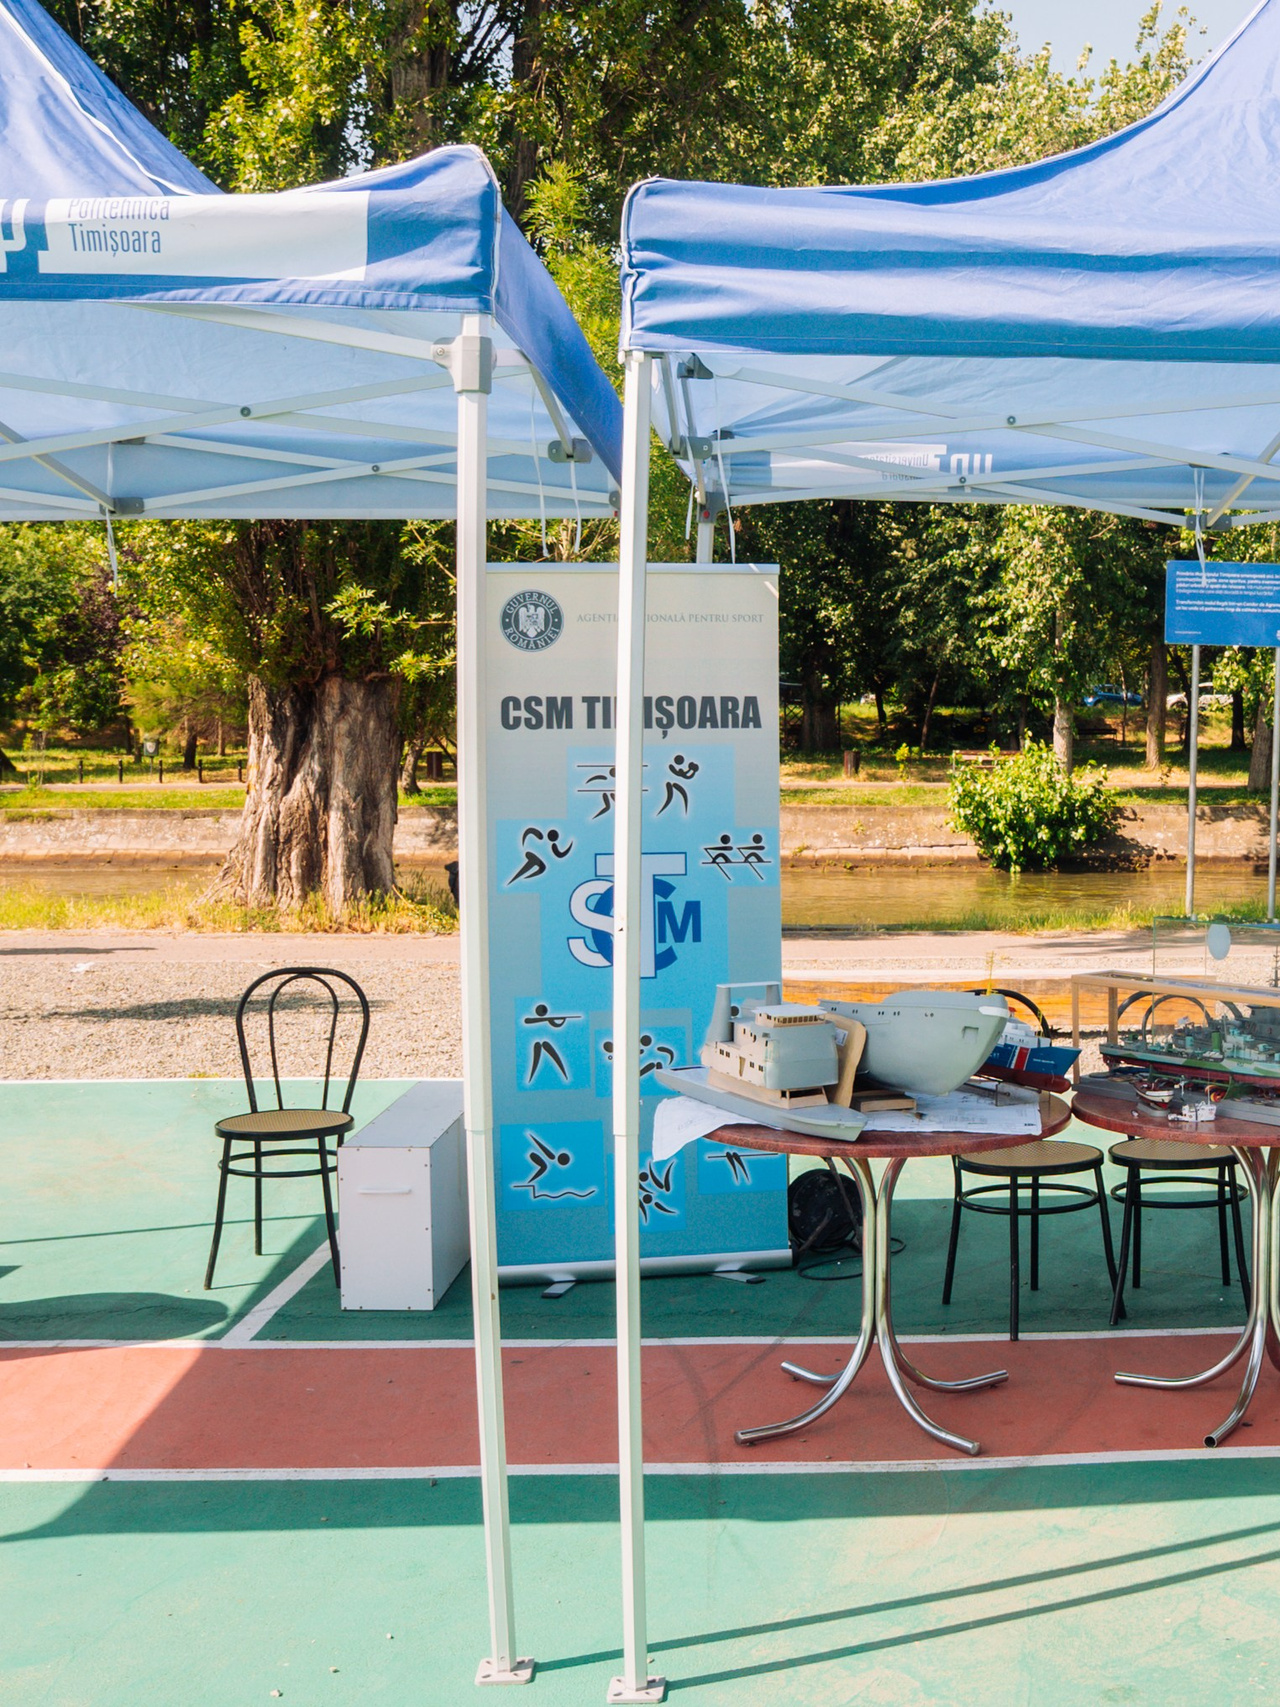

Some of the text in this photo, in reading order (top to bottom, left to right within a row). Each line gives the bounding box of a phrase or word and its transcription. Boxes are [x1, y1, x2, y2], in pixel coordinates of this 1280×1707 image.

[67, 222, 162, 258] Timișoara
[505, 591, 556, 615] GUVERNUL
[645, 611, 685, 623] IONALĂ
[688, 612, 729, 623] PENTRU
[731, 612, 764, 623] SPORT
[504, 625, 561, 651] ROMÂNIEI
[500, 695, 762, 739] CSM TIIȘOARA
